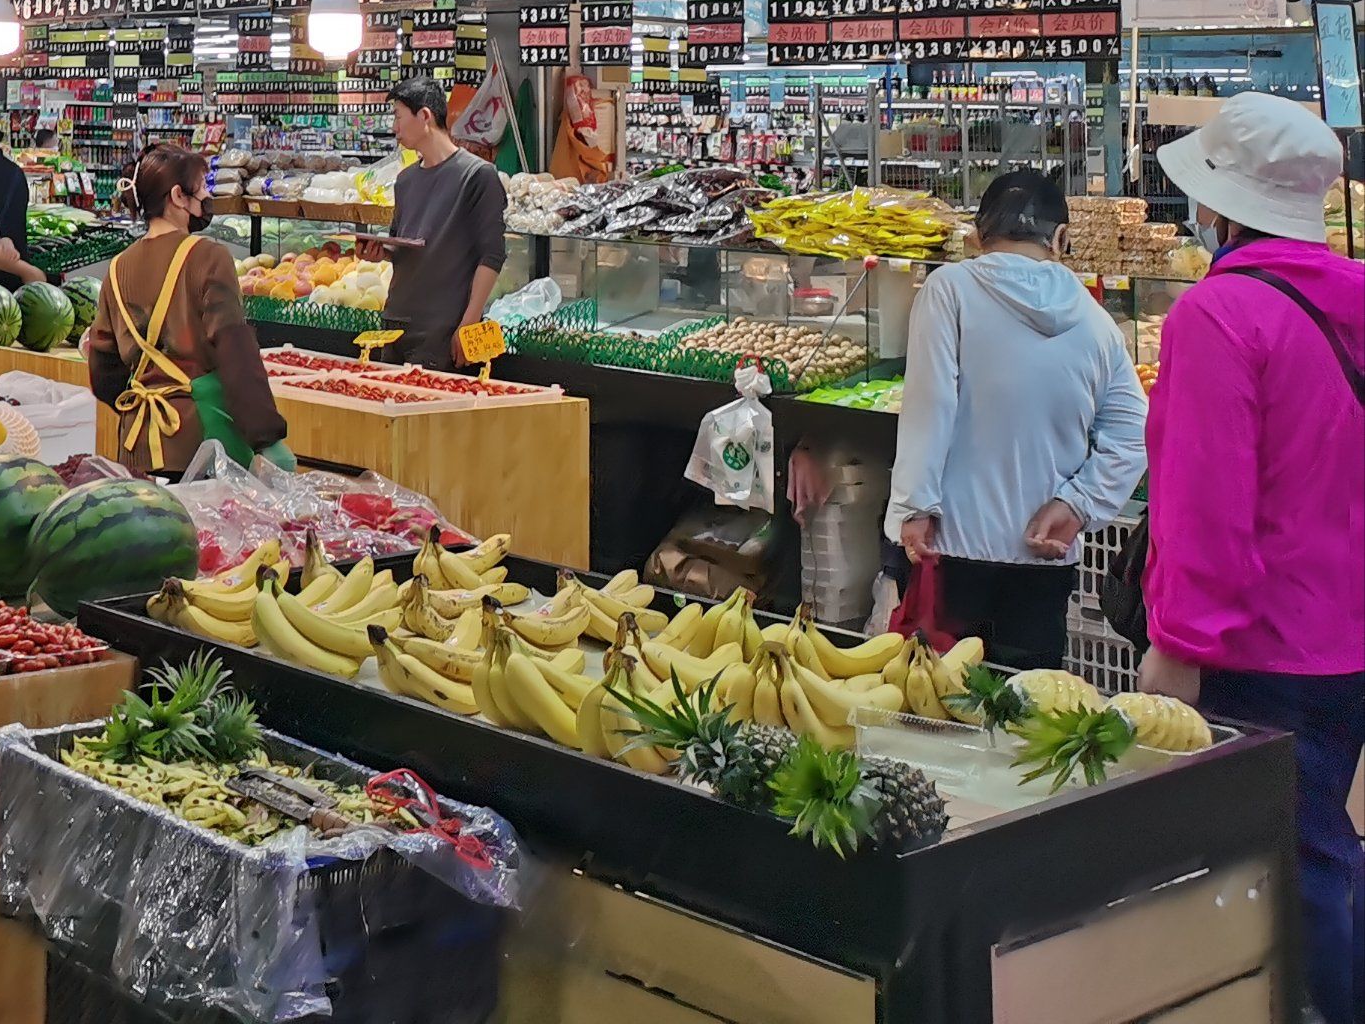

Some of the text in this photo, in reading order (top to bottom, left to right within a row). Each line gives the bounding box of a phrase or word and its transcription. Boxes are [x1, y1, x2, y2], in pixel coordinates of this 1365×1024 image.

[909, 19, 954, 35] 会员价
[979, 17, 1029, 33] 会员价
[1053, 14, 1105, 31] 会员价
[526, 31, 559, 43] 会员价
[591, 31, 626, 42] 会员价
[776, 27, 816, 41] 会员价
[841, 23, 884, 38] 会员价
[1045, 39, 1102, 57] ¥5.00
